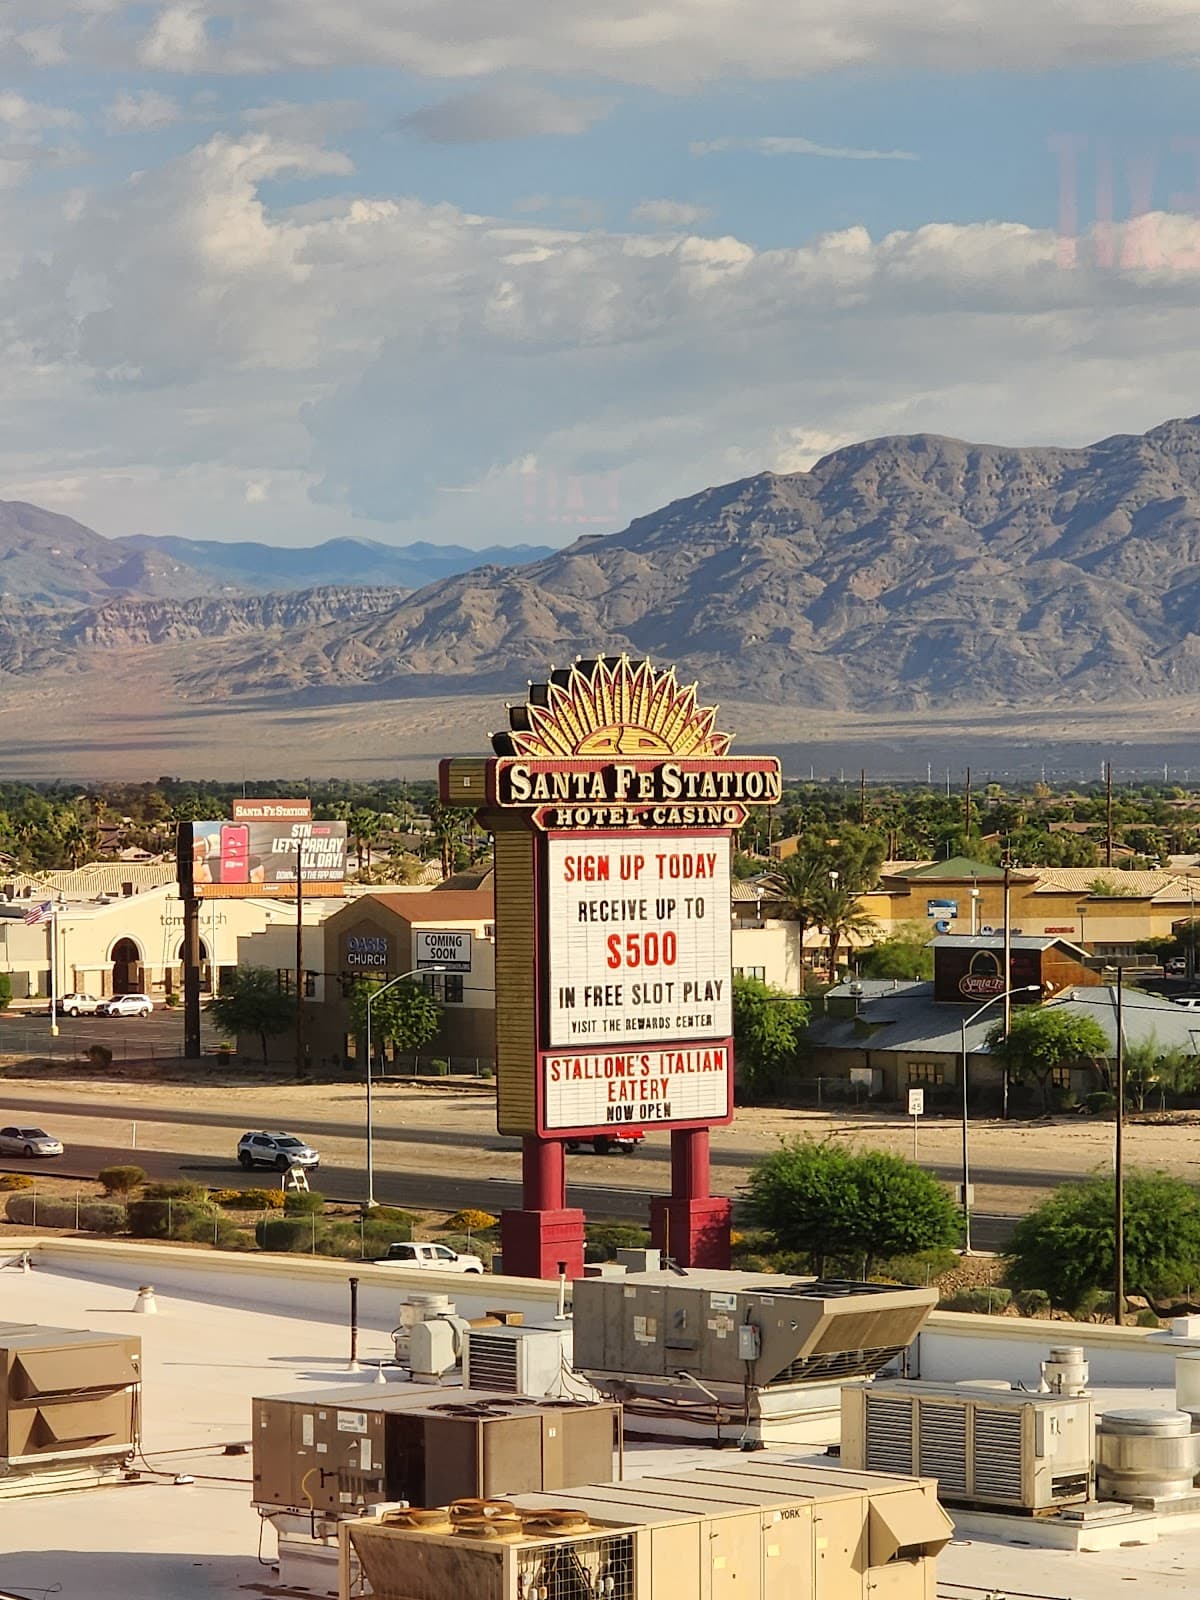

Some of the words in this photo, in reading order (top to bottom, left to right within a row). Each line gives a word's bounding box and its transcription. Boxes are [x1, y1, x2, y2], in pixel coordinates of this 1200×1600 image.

[556, 807, 640, 826] HOTEL
[652, 805, 738, 824] CASINO
[291, 824, 312, 837] STN
[301, 838, 344, 853] PARLAY
[317, 853, 343, 867] DAY!
[563, 855, 610, 882] SIGN
[620, 855, 645, 880] UP
[655, 853, 717, 879] TODAY
[578, 899, 647, 922] RECEIVE
[656, 898, 676, 920] UP
[685, 897, 705, 919] TO
[350, 936, 387, 951] OASIS
[425, 935, 462, 947] COMING
[430, 948, 457, 960] SOON
[607, 931, 677, 969] $500
[347, 953, 386, 966] CHURCH
[559, 986, 575, 1008] IN
[584, 984, 623, 1007] FREE
[632, 982, 674, 1005] SLOT
[683, 980, 723, 1003] PLAY
[572, 1020, 596, 1033] VISIT
[603, 1018, 621, 1032] THE
[625, 1016, 671, 1030] REWARDS
[676, 1014, 712, 1029] CENTER
[551, 1055, 650, 1081] STALLONE'S
[660, 1050, 724, 1075] ITALIAN
[608, 1078, 669, 1102] EATERY
[606, 1104, 634, 1121] NOW
[639, 1102, 671, 1119] OPEN
[911, 1103, 922, 1112] 45
[780, 1509, 800, 1520] YORK
